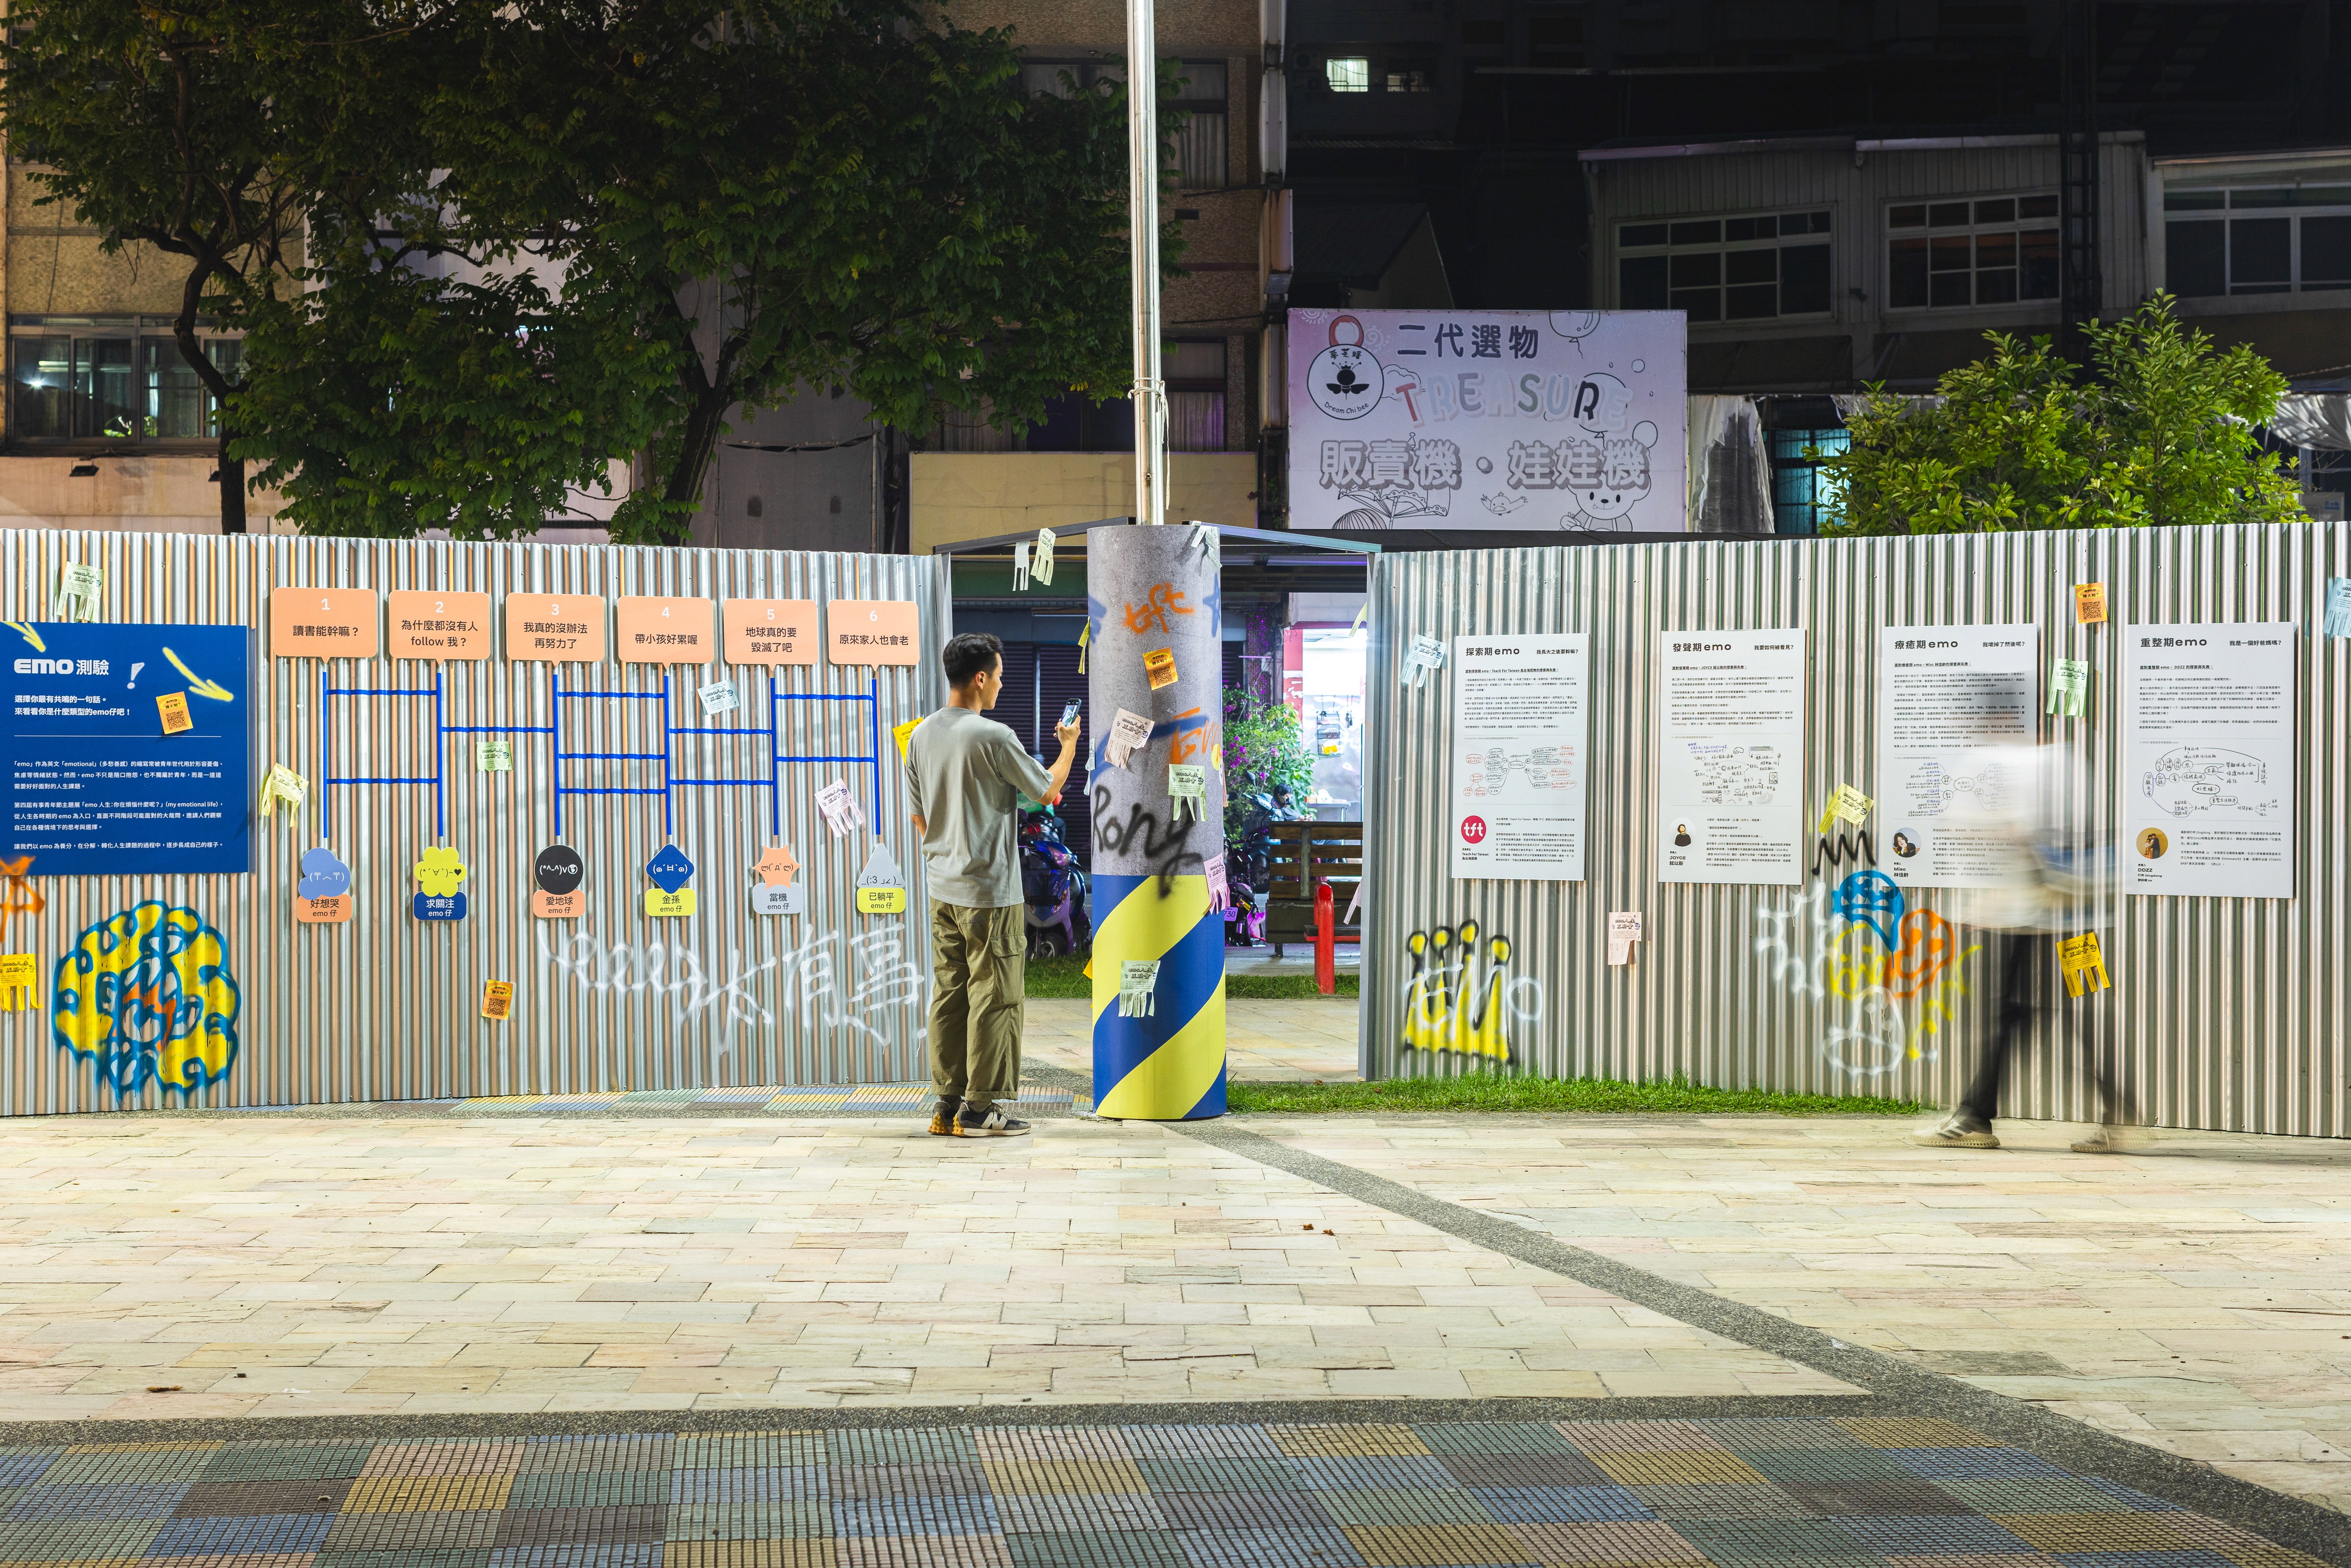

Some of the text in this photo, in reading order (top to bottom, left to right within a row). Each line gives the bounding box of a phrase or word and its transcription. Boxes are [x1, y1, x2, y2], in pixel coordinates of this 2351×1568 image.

[1397, 323, 1539, 359] 二代選物
[1324, 402, 1344, 414] Dream
[1357, 403, 1369, 411] bee
[321, 598, 330, 611] 1
[435, 601, 444, 613] 2
[551, 604, 559, 616] 3
[661, 607, 670, 618] 4
[767, 609, 775, 620] 5
[869, 610, 878, 622] 6
[293, 625, 358, 637] 讀書能幹嘛？
[402, 620, 478, 632] 為什麼都沒有人
[523, 622, 588, 634] 我真的沒辦法
[745, 627, 796, 638] 地球真的要
[411, 637, 444, 647] follow
[534, 638, 577, 649] 再努力了
[635, 634, 697, 645] 帶小孩好累喔
[839, 634, 909, 646] 原來家人也會老
[751, 642, 792, 653] 毀滅了吧
[14, 695, 106, 704] 選擇你最有共鳴的一句話。
[1463, 822, 1483, 836] tft
[546, 896, 573, 906] 愛地球
[662, 895, 680, 904] 金孫
[769, 893, 787, 902] 當機
[869, 892, 894, 902] 已躺平
[310, 899, 339, 908] 好想哭
[426, 899, 454, 909] 求關注
[699, 923, 927, 1054] 太有事
